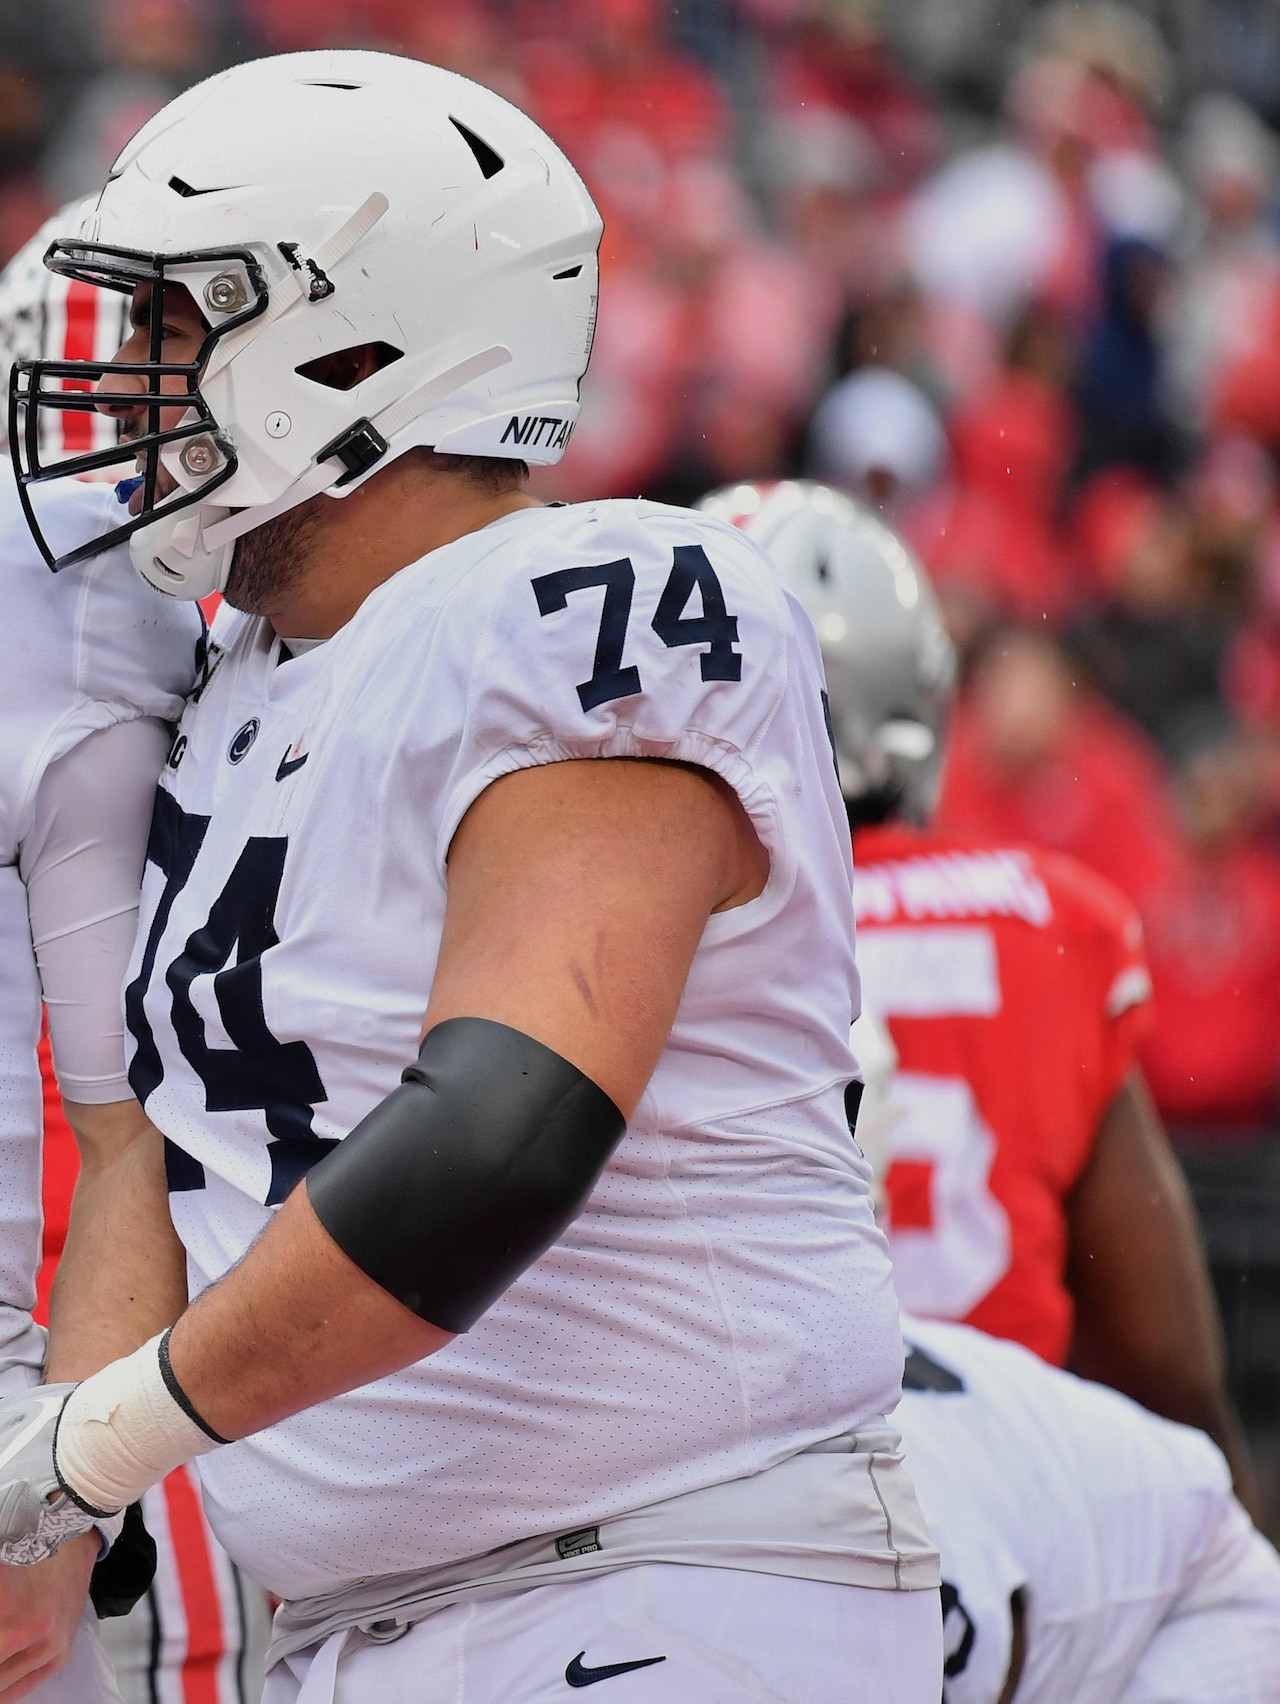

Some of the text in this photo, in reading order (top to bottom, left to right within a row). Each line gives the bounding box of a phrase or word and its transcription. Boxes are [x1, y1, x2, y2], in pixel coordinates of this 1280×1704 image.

[499, 416, 577, 450] NITTAN
[530, 544, 742, 713] 74
[125, 785, 342, 1207] 74
[562, 1543, 598, 1559] NIKE PRO
